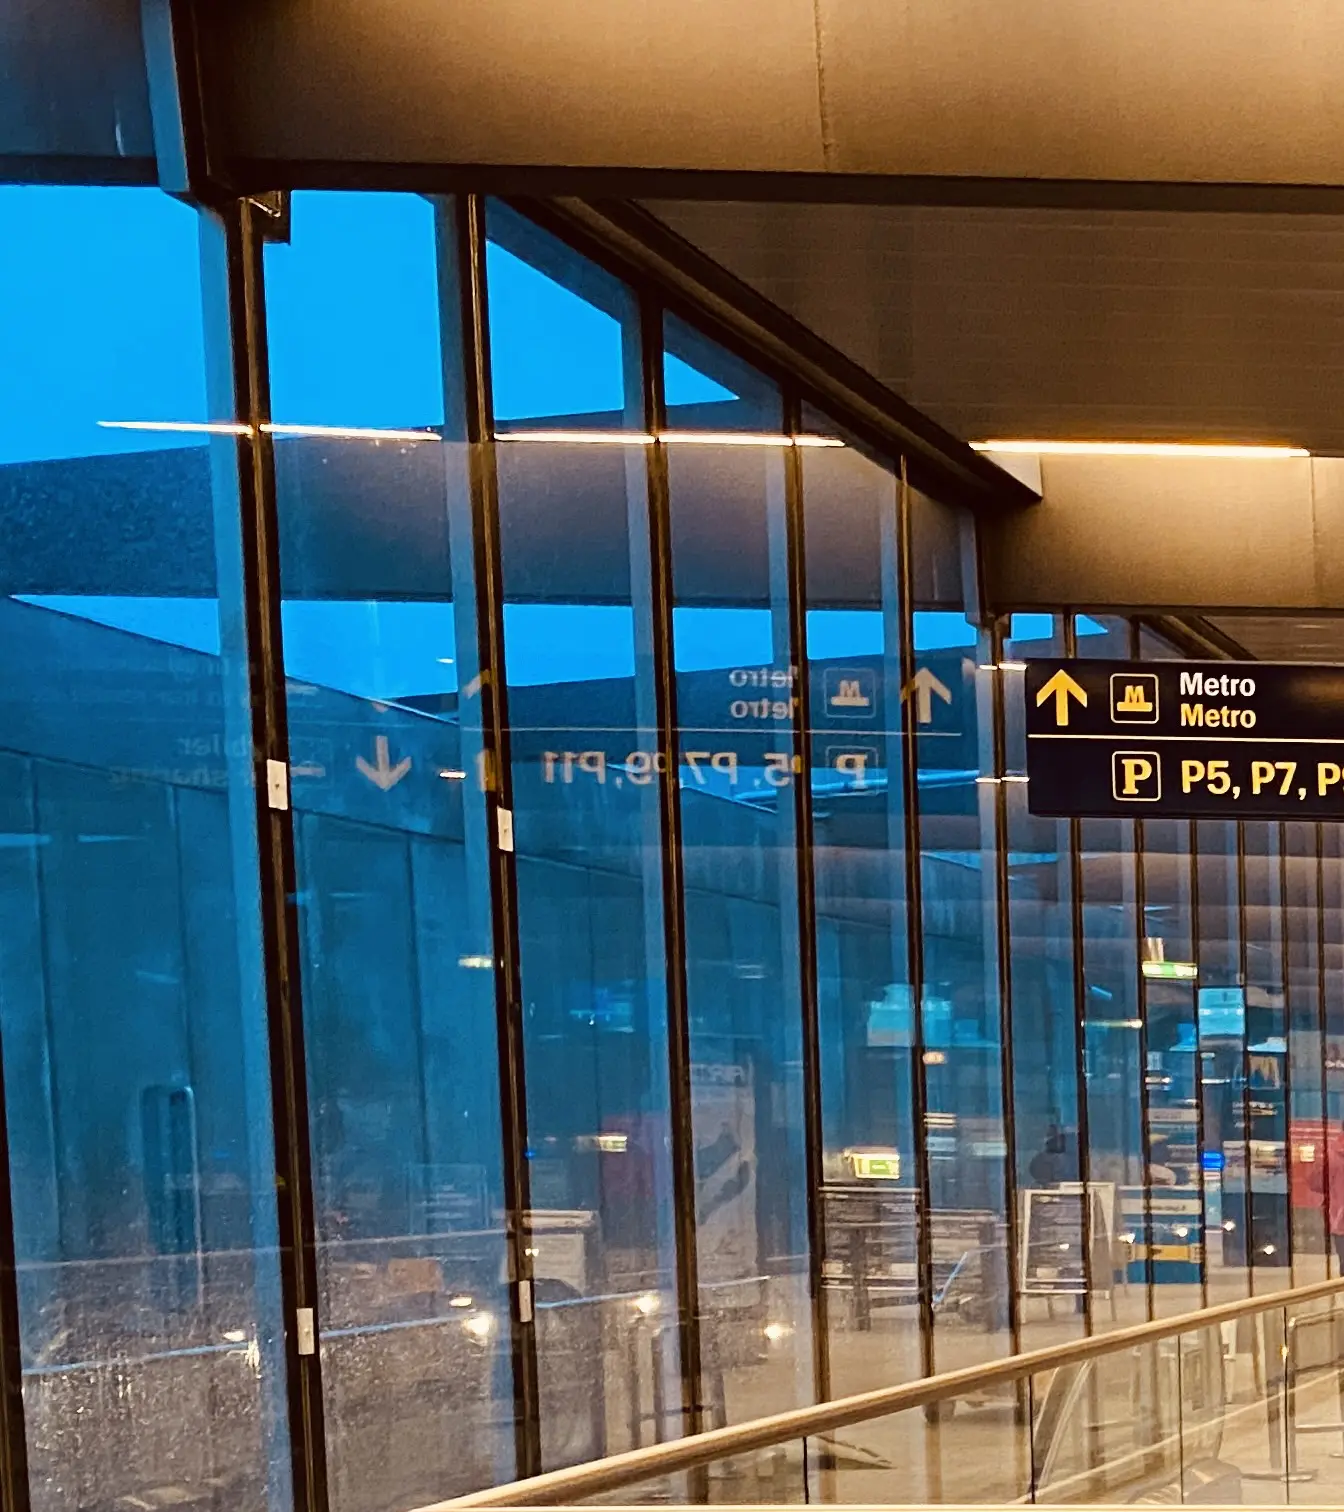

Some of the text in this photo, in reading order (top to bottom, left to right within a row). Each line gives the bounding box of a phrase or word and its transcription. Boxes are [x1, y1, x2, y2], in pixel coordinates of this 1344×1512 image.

[1180, 671, 1256, 697] Metro
[1180, 702, 1257, 729] Metro
[1121, 758, 1153, 794] P
[1181, 759, 1241, 800] P5,
[1251, 760, 1307, 801] P7,
